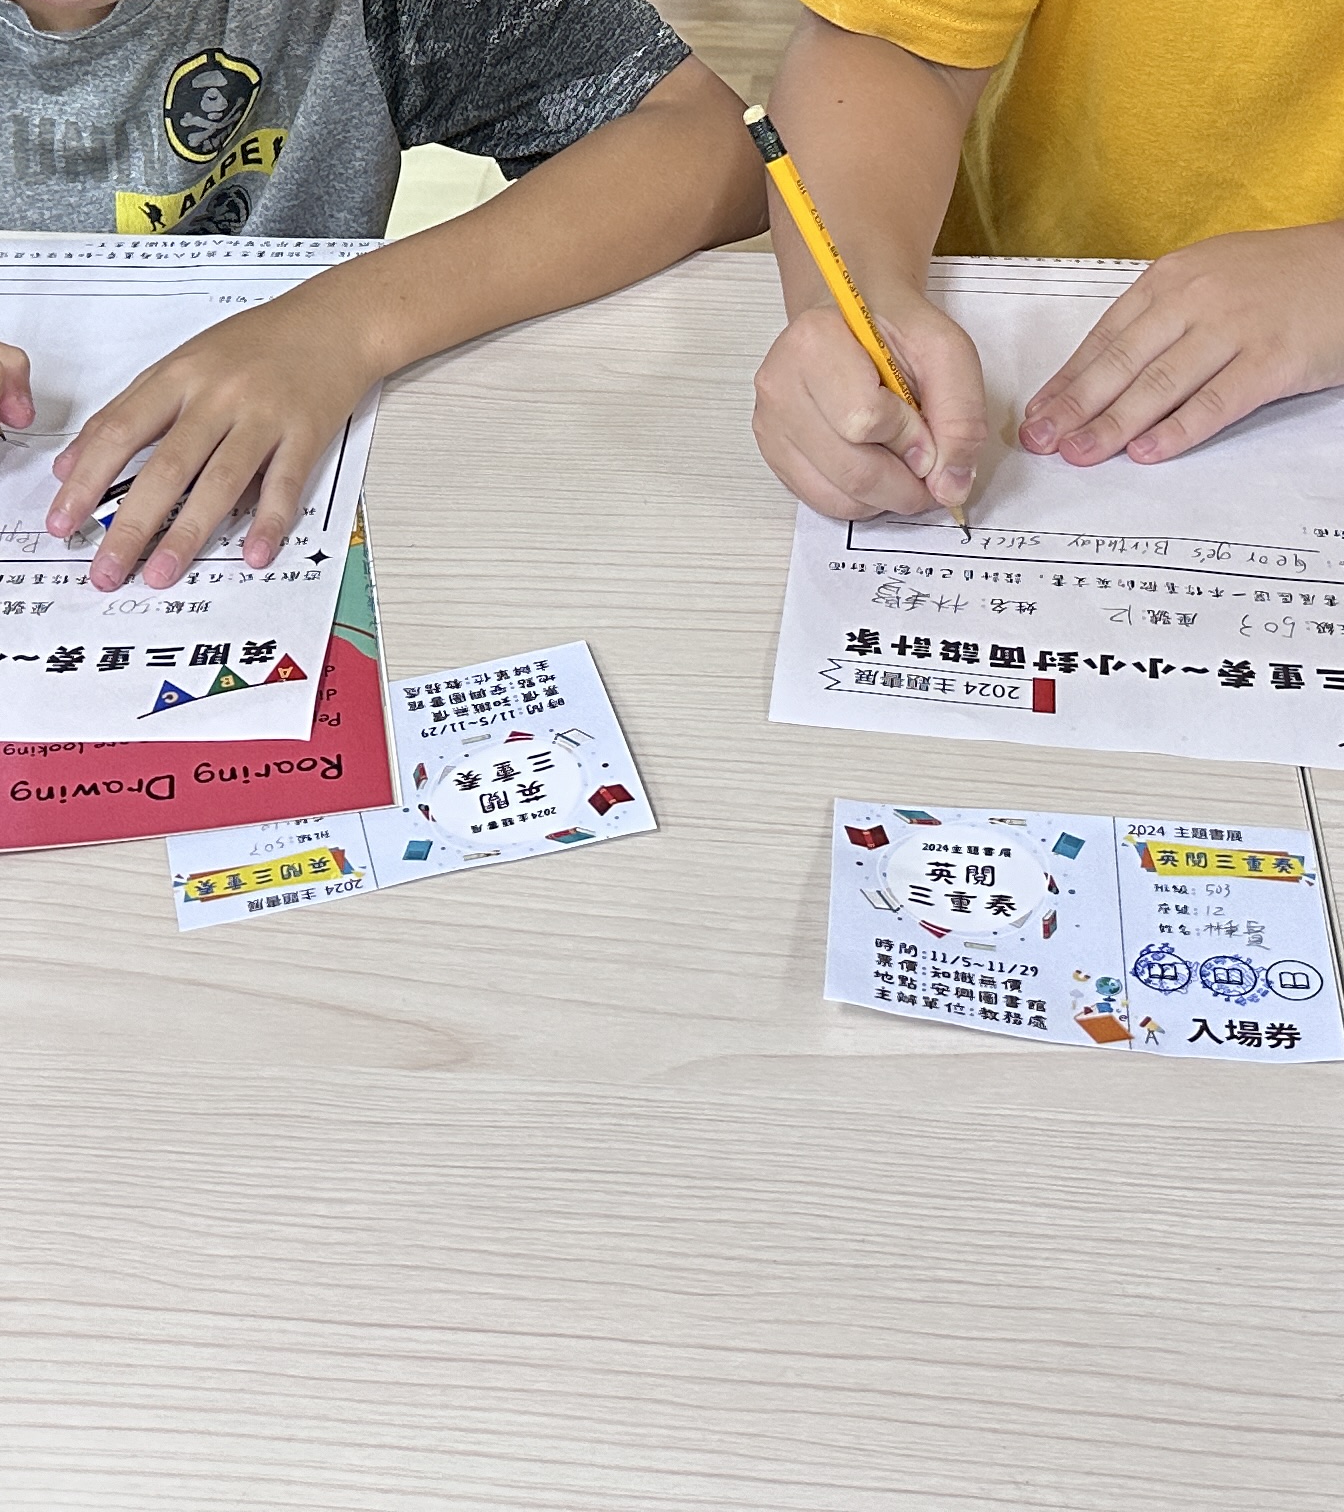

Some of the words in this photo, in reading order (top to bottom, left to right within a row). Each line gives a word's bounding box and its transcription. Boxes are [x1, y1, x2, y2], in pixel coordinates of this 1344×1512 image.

[178, 136, 263, 220] AAPE
[842, 269, 860, 299] LEAD
[220, 674, 236, 689] B
[277, 665, 294, 683] A
[853, 667, 956, 695] 主題書展
[161, 689, 180, 705] C
[962, 680, 1021, 701] 2024
[313, 710, 341, 728] Pe
[2, 741, 85, 758] looking
[193, 753, 344, 785] Roaring
[452, 750, 556, 792] 三重奏
[9, 773, 176, 805] Drawing
[1127, 824, 1166, 838] 2024
[1173, 825, 1244, 843] 主題書展
[246, 886, 317, 913] 主題書展
[324, 878, 364, 897] 2024
[1205, 882, 1231, 898] 503
[907, 884, 1018, 917] 三重奏
[1187, 1017, 1302, 1050] 入場券
